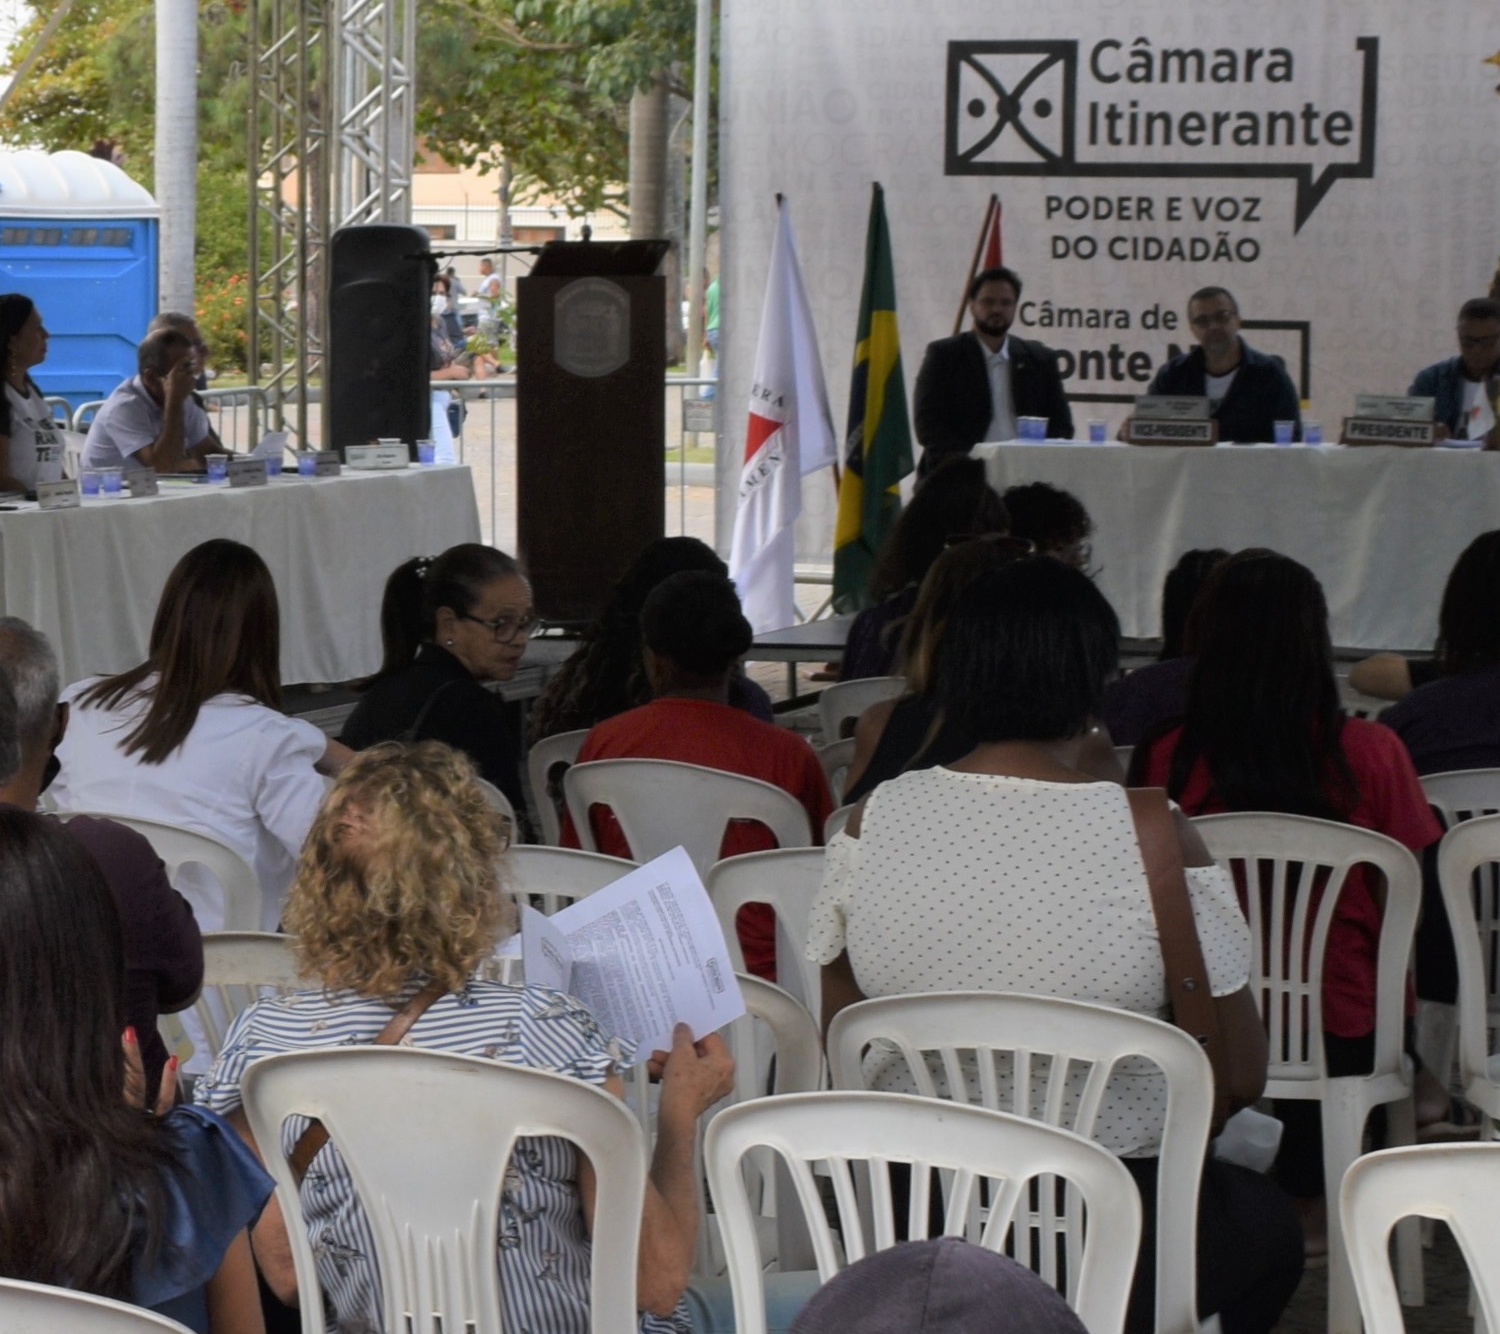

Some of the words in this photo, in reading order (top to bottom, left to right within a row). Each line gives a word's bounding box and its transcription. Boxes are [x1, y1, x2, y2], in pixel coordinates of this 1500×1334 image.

[1089, 36, 1294, 84] Câmara
[1088, 101, 1353, 147] Itinerante
[1046, 195, 1154, 221] PODER
[1166, 197, 1182, 221] E
[1191, 197, 1262, 222] VOZ
[1051, 235, 1098, 260] DO
[1107, 231, 1261, 263] CIDADÃO
[1019, 300, 1131, 329] Câmara
[1141, 303, 1179, 330] de
[1057, 344, 1153, 382] onte
[1351, 423, 1429, 440] PRESIDENTE
